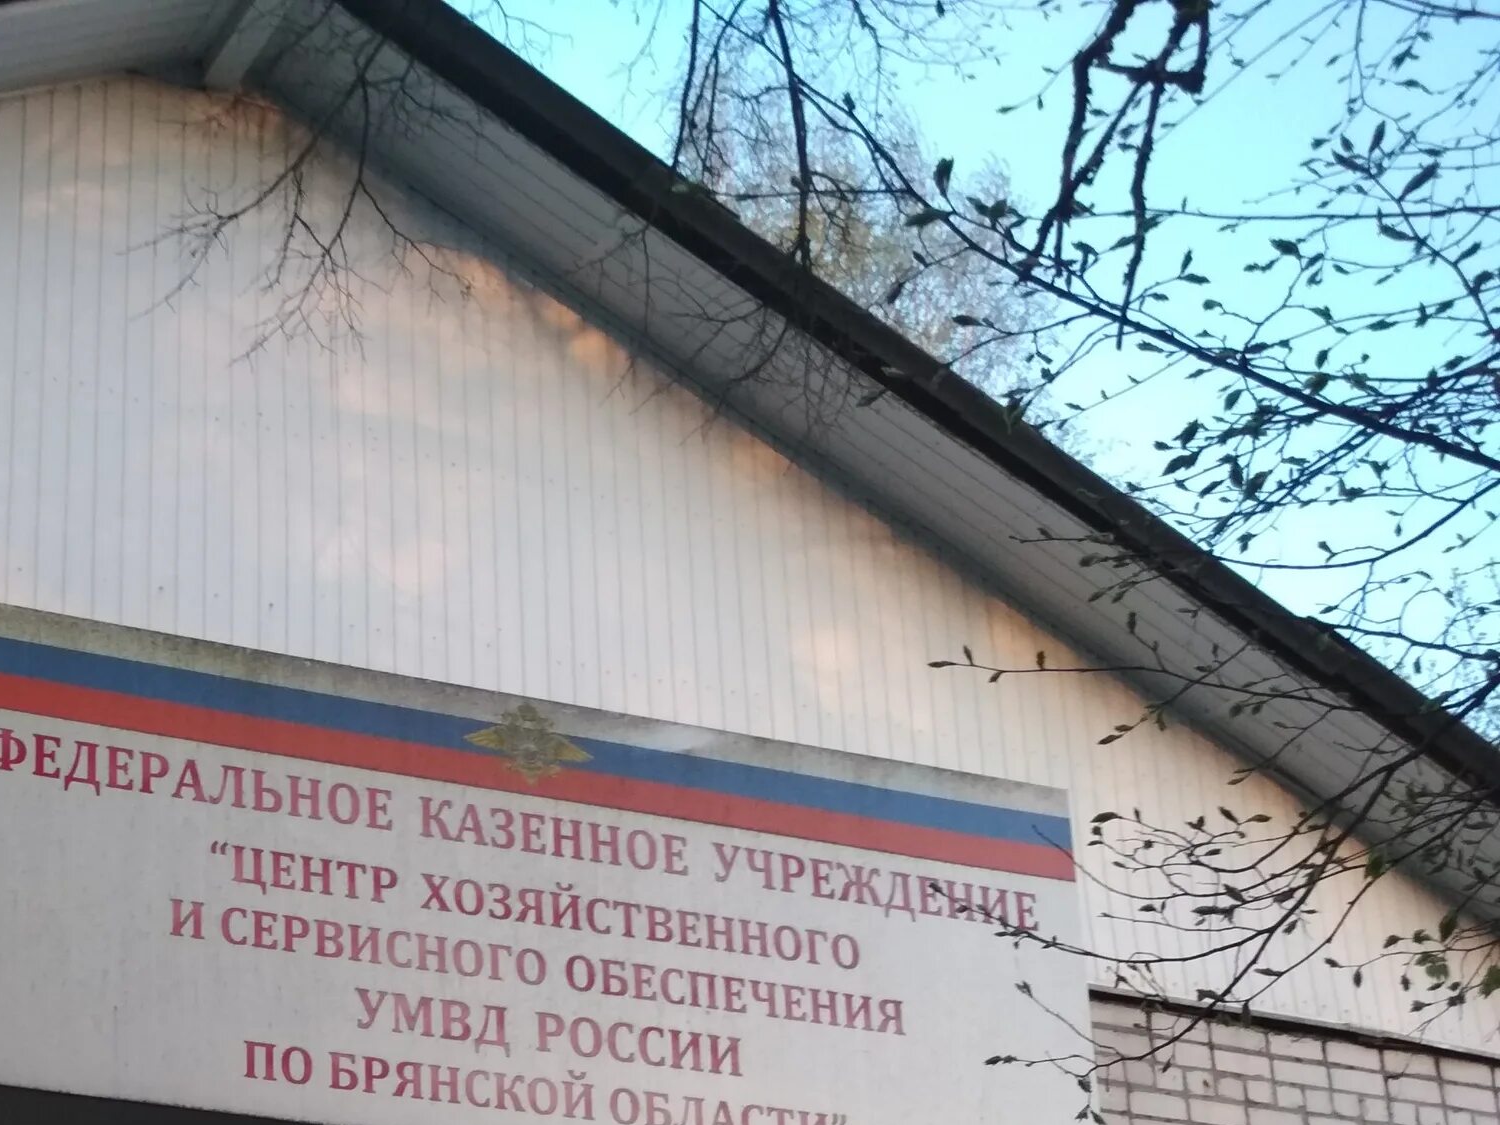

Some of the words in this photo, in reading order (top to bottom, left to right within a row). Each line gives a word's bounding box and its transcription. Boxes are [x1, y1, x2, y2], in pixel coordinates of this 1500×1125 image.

[420, 797, 688, 876] КАЗЕННОЕ
[712, 841, 1040, 933] УЧРЕЖДЕНИЕ
[169, 898, 206, 941] И
[220, 907, 547, 987] СЕРВИСНОГО
[565, 954, 905, 1036] ОБЕСПЕЧЕНИЯ
[419, 873, 861, 970] ХОЗЯЙСТВЕННОГО
[243, 1040, 314, 1085] ПО
[329, 1051, 596, 1122] БРЯНСКОЙ
[356, 988, 510, 1057] УМВД
[536, 1011, 744, 1077] РОССИИ
